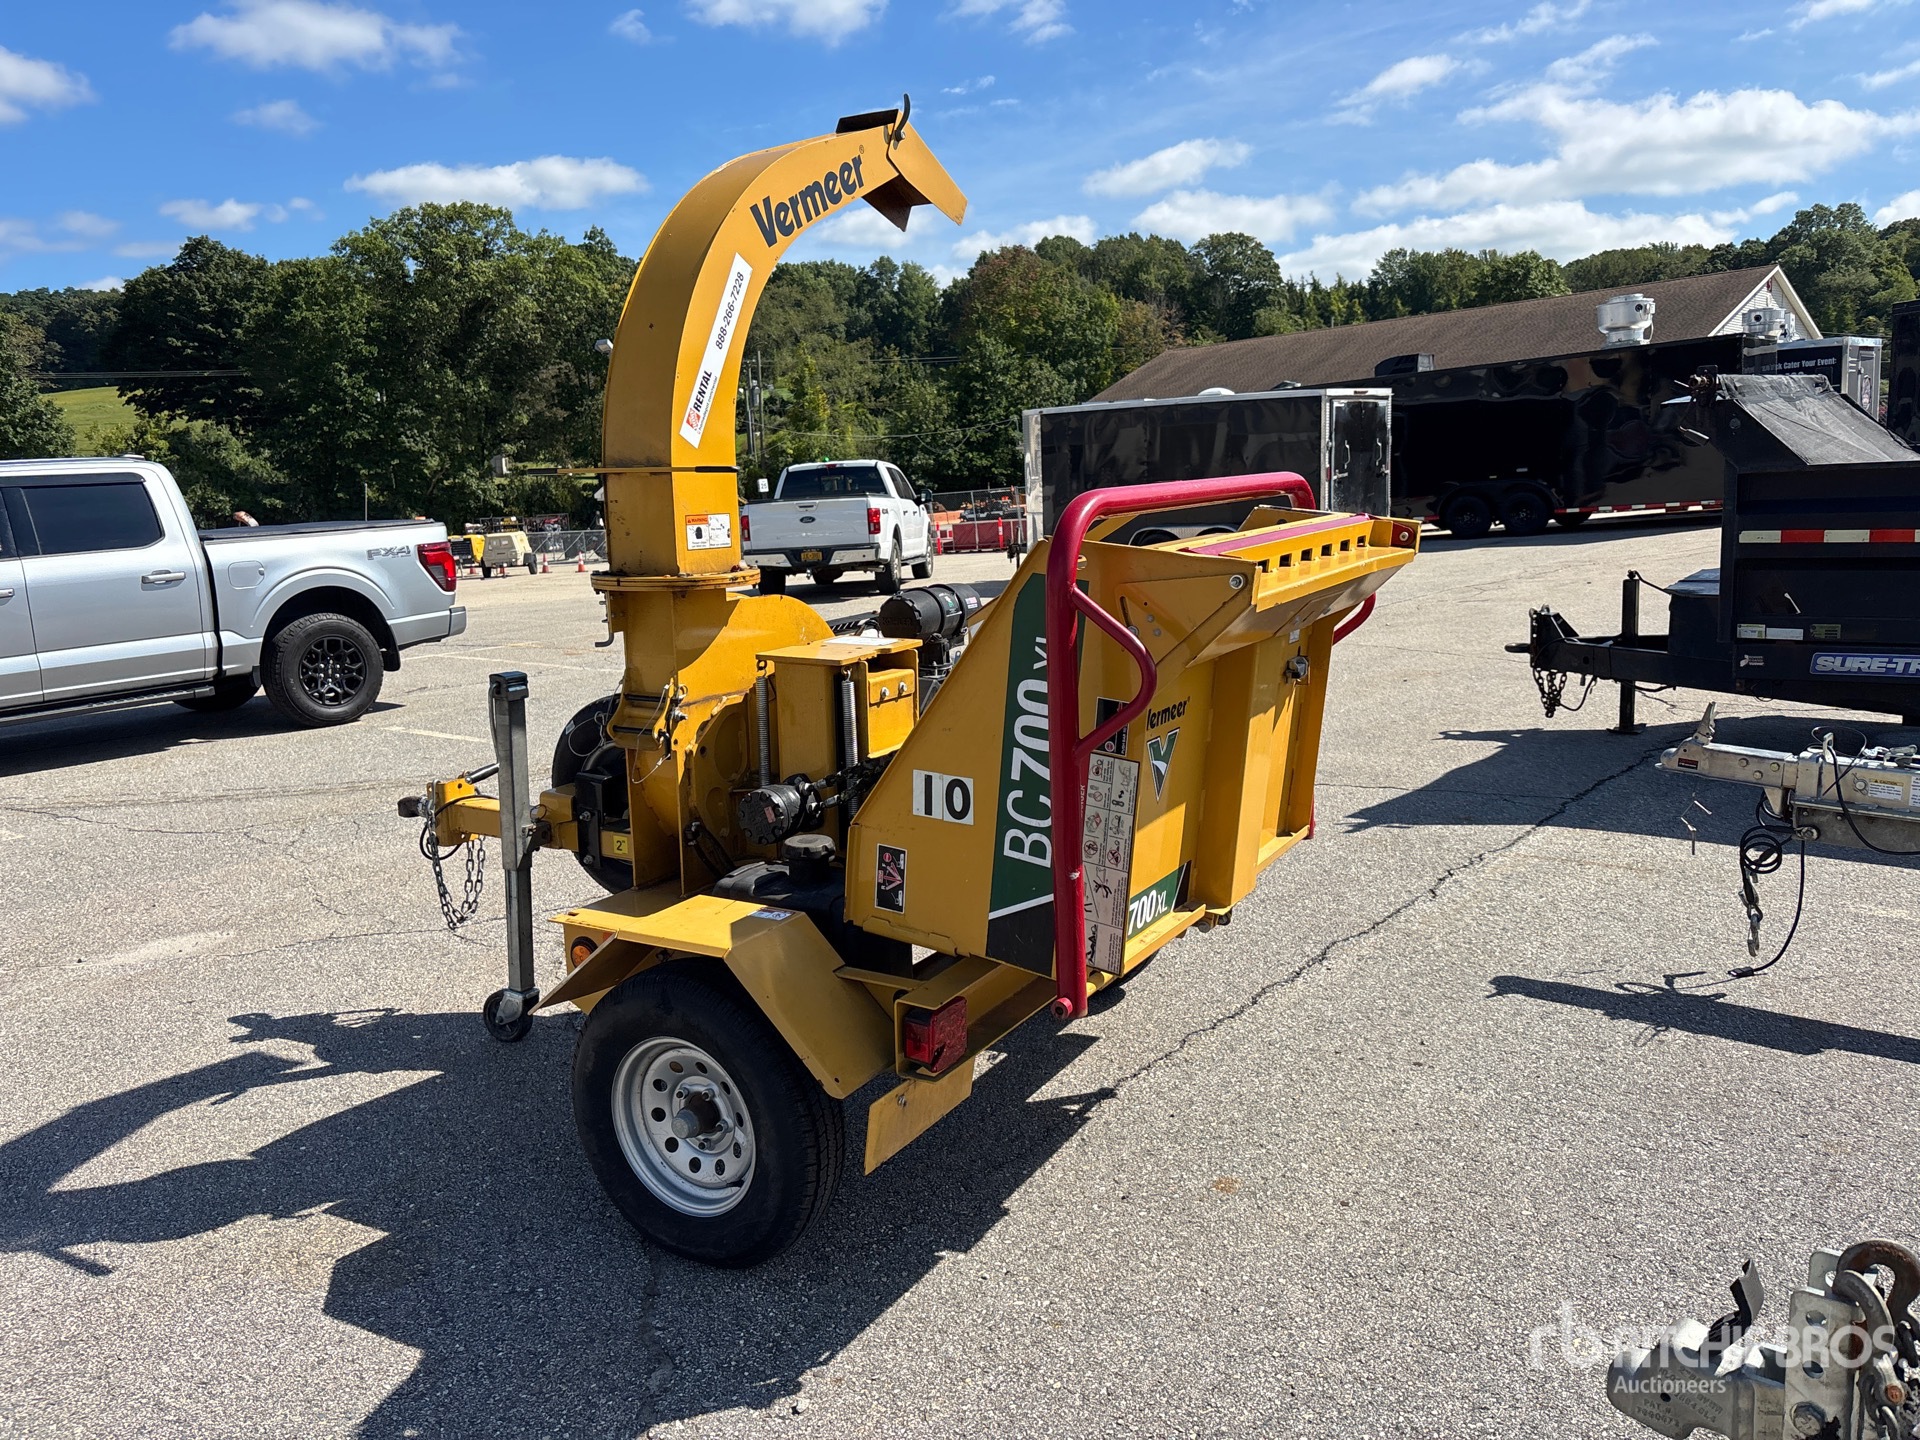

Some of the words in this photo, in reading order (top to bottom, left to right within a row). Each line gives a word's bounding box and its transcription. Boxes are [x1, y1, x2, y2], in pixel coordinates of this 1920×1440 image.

[750, 154, 865, 247] Vermeer
[714, 270, 745, 350] 888-266-7228
[1801, 359, 1816, 367] Your
[692, 370, 713, 413] RENTAL
[367, 545, 411, 560] FX4
[924, 774, 971, 820] 10
